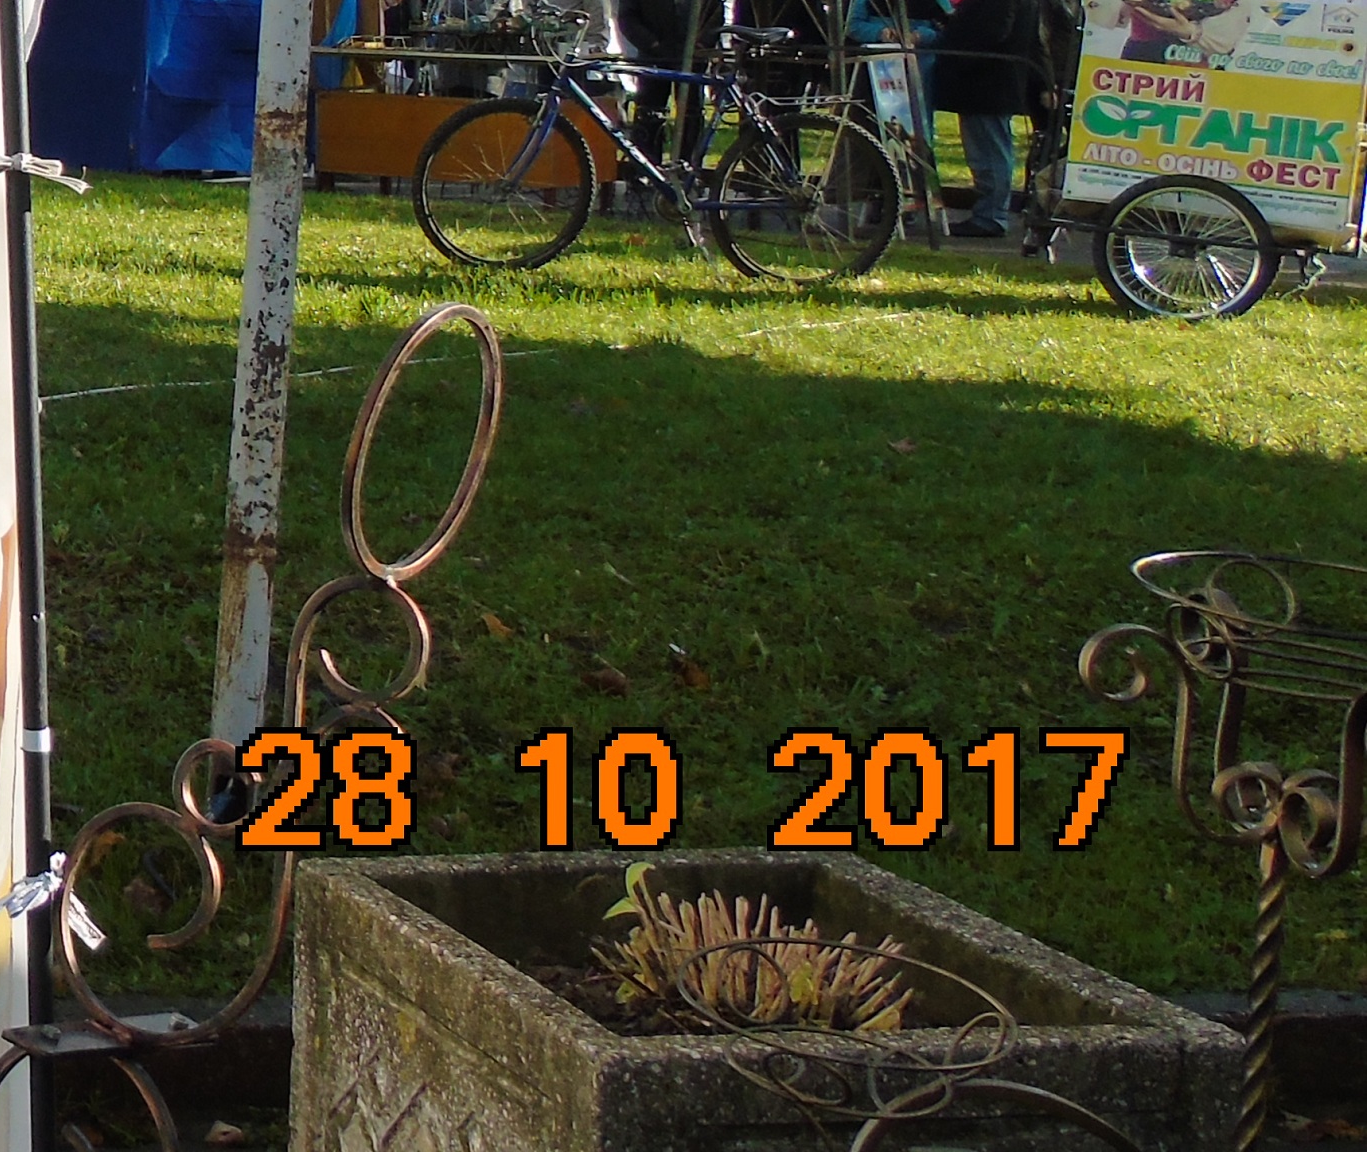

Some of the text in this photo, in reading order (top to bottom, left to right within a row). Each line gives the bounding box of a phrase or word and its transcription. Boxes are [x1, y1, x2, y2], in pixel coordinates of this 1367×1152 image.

[1092, 68, 1206, 103] СТРИЙ
[1082, 143, 1138, 167] ЛІТО
[1157, 152, 1239, 181] ОСІНЬ
[1246, 159, 1341, 190] ФЕСТ
